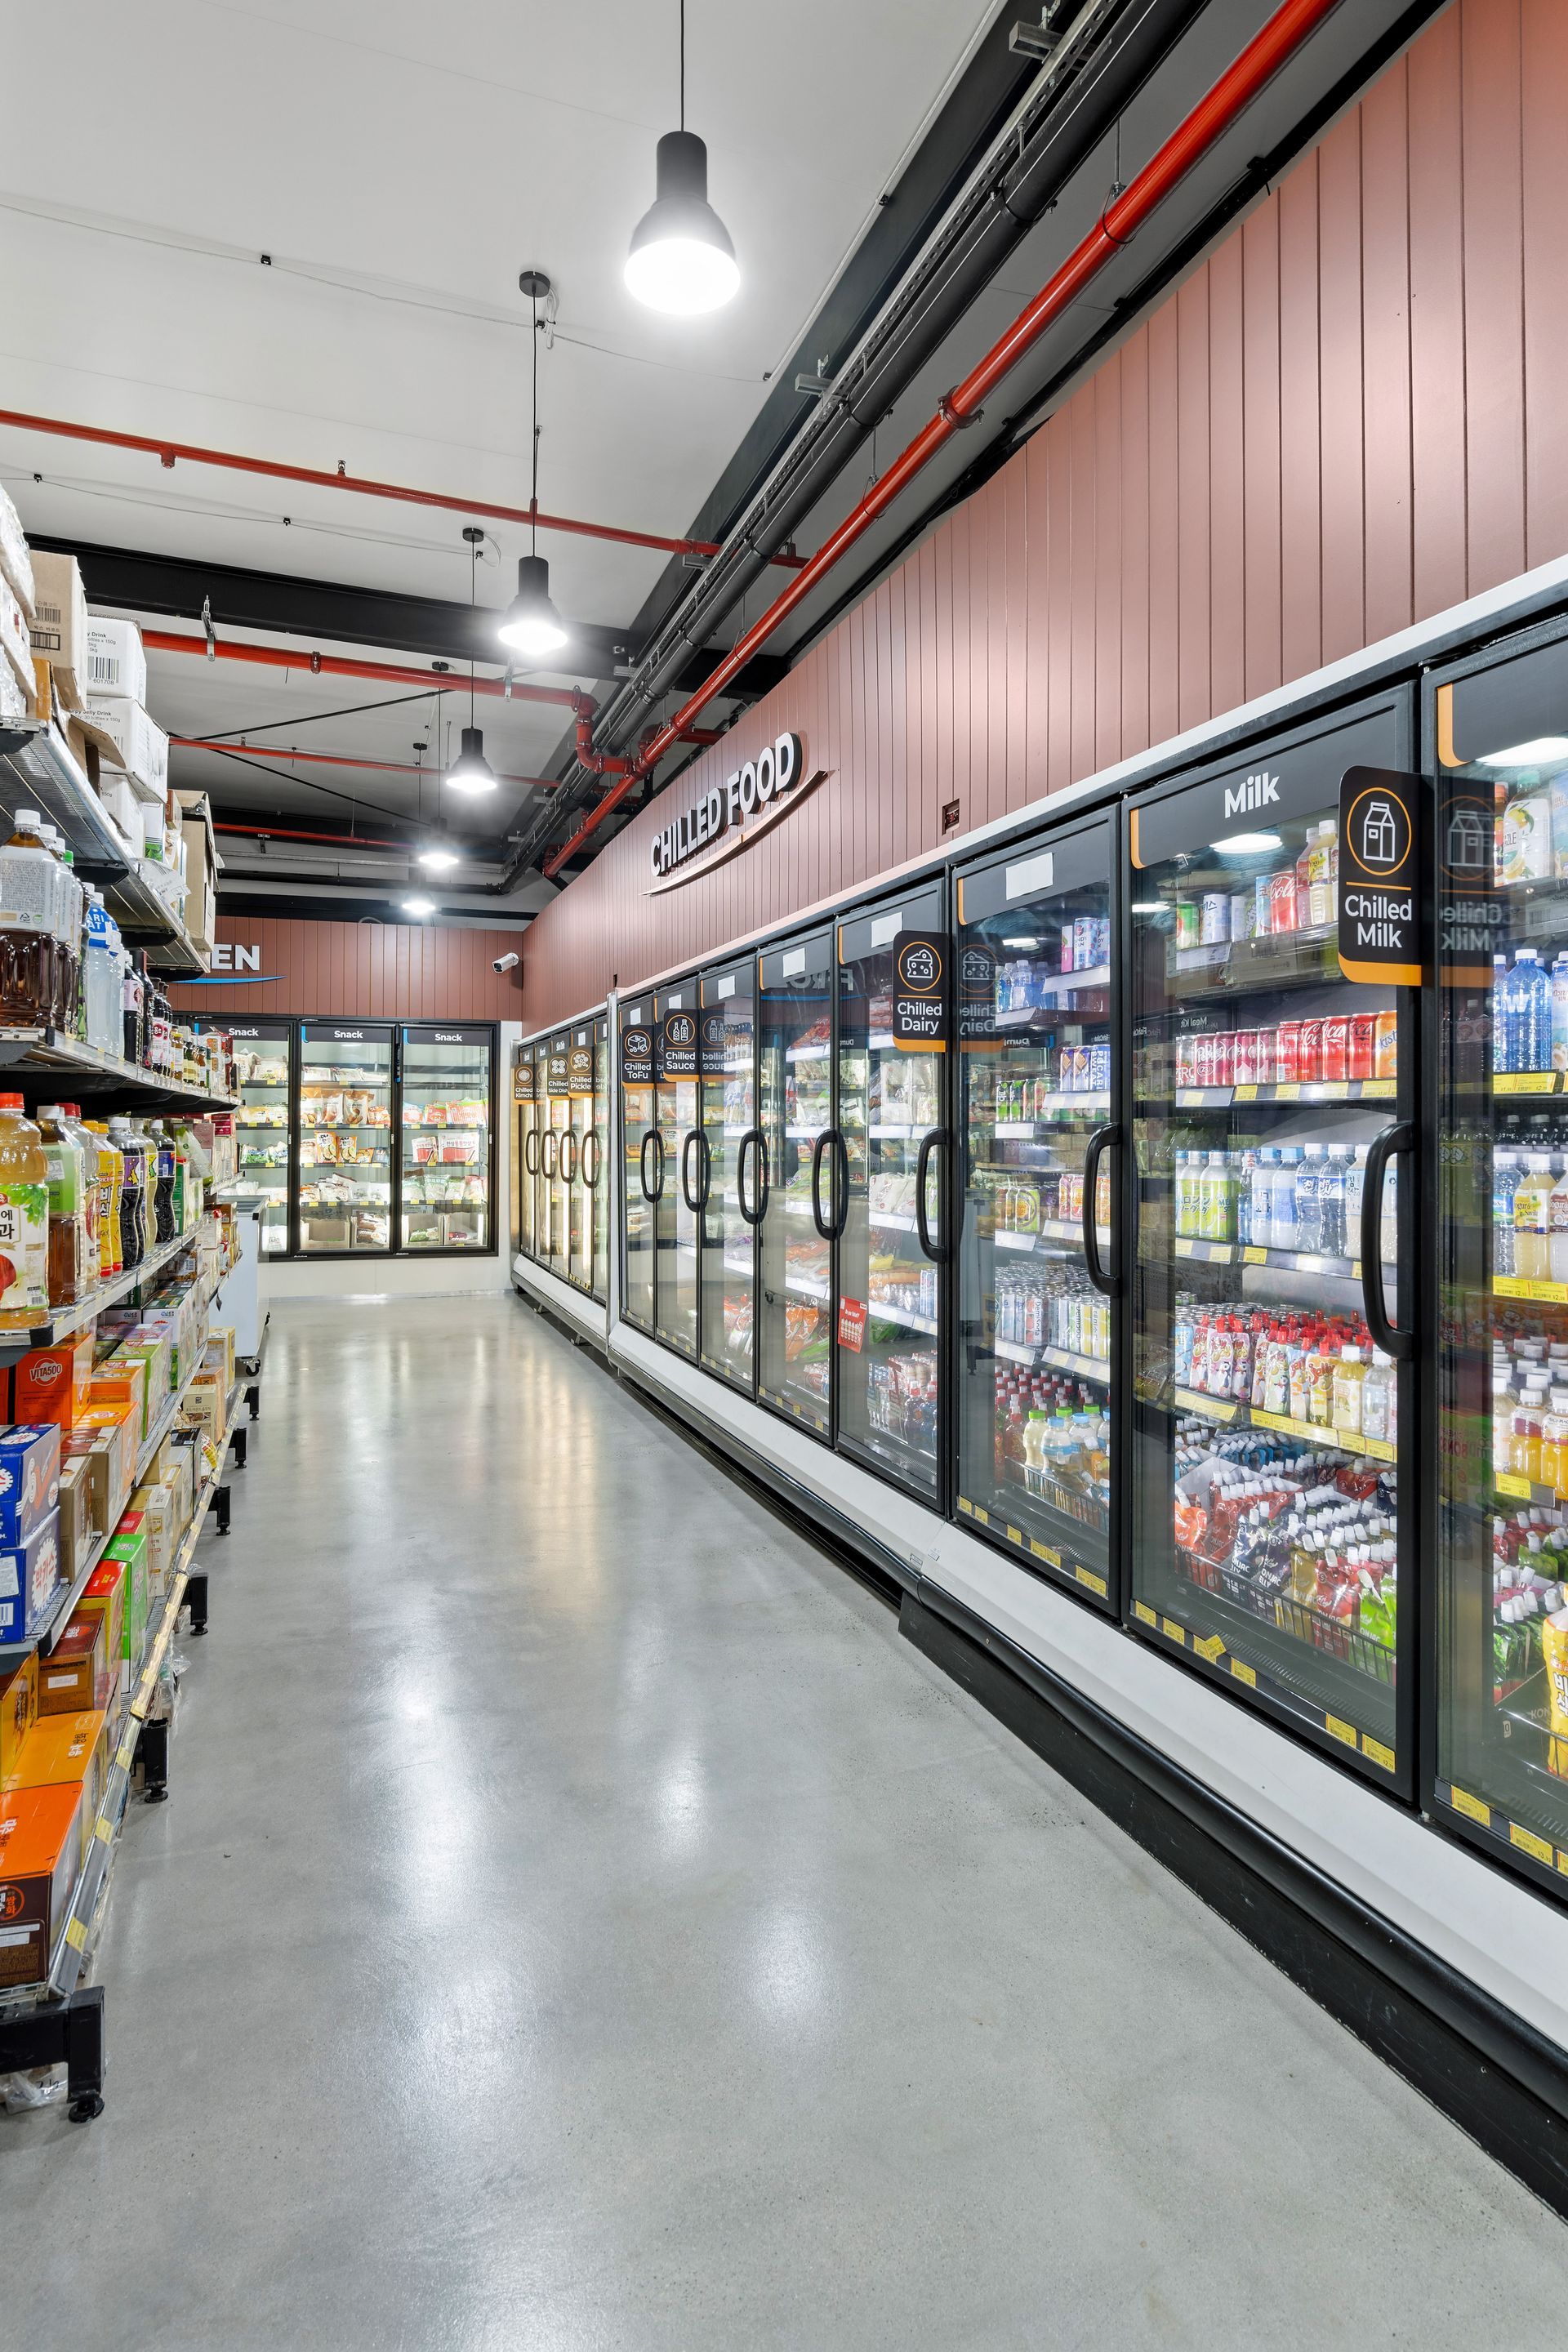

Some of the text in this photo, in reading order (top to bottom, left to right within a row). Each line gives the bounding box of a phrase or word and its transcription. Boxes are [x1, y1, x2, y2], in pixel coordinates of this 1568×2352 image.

[1225, 772, 1281, 818] Milk
[651, 732, 798, 877] CHILLED FOOD
[1345, 895, 1412, 921] Chilled
[1357, 923, 1402, 948] Milk
[898, 1002, 942, 1016] Chilled
[229, 1028, 259, 1036] Snack
[902, 1018, 939, 1035] Dairy
[334, 1031, 363, 1039] Snack
[434, 1033, 463, 1042] Snack
[666, 1052, 696, 1060] Chilled
[666, 1062, 696, 1070] Sauce
[30, 1364, 62, 1381] VITA500
